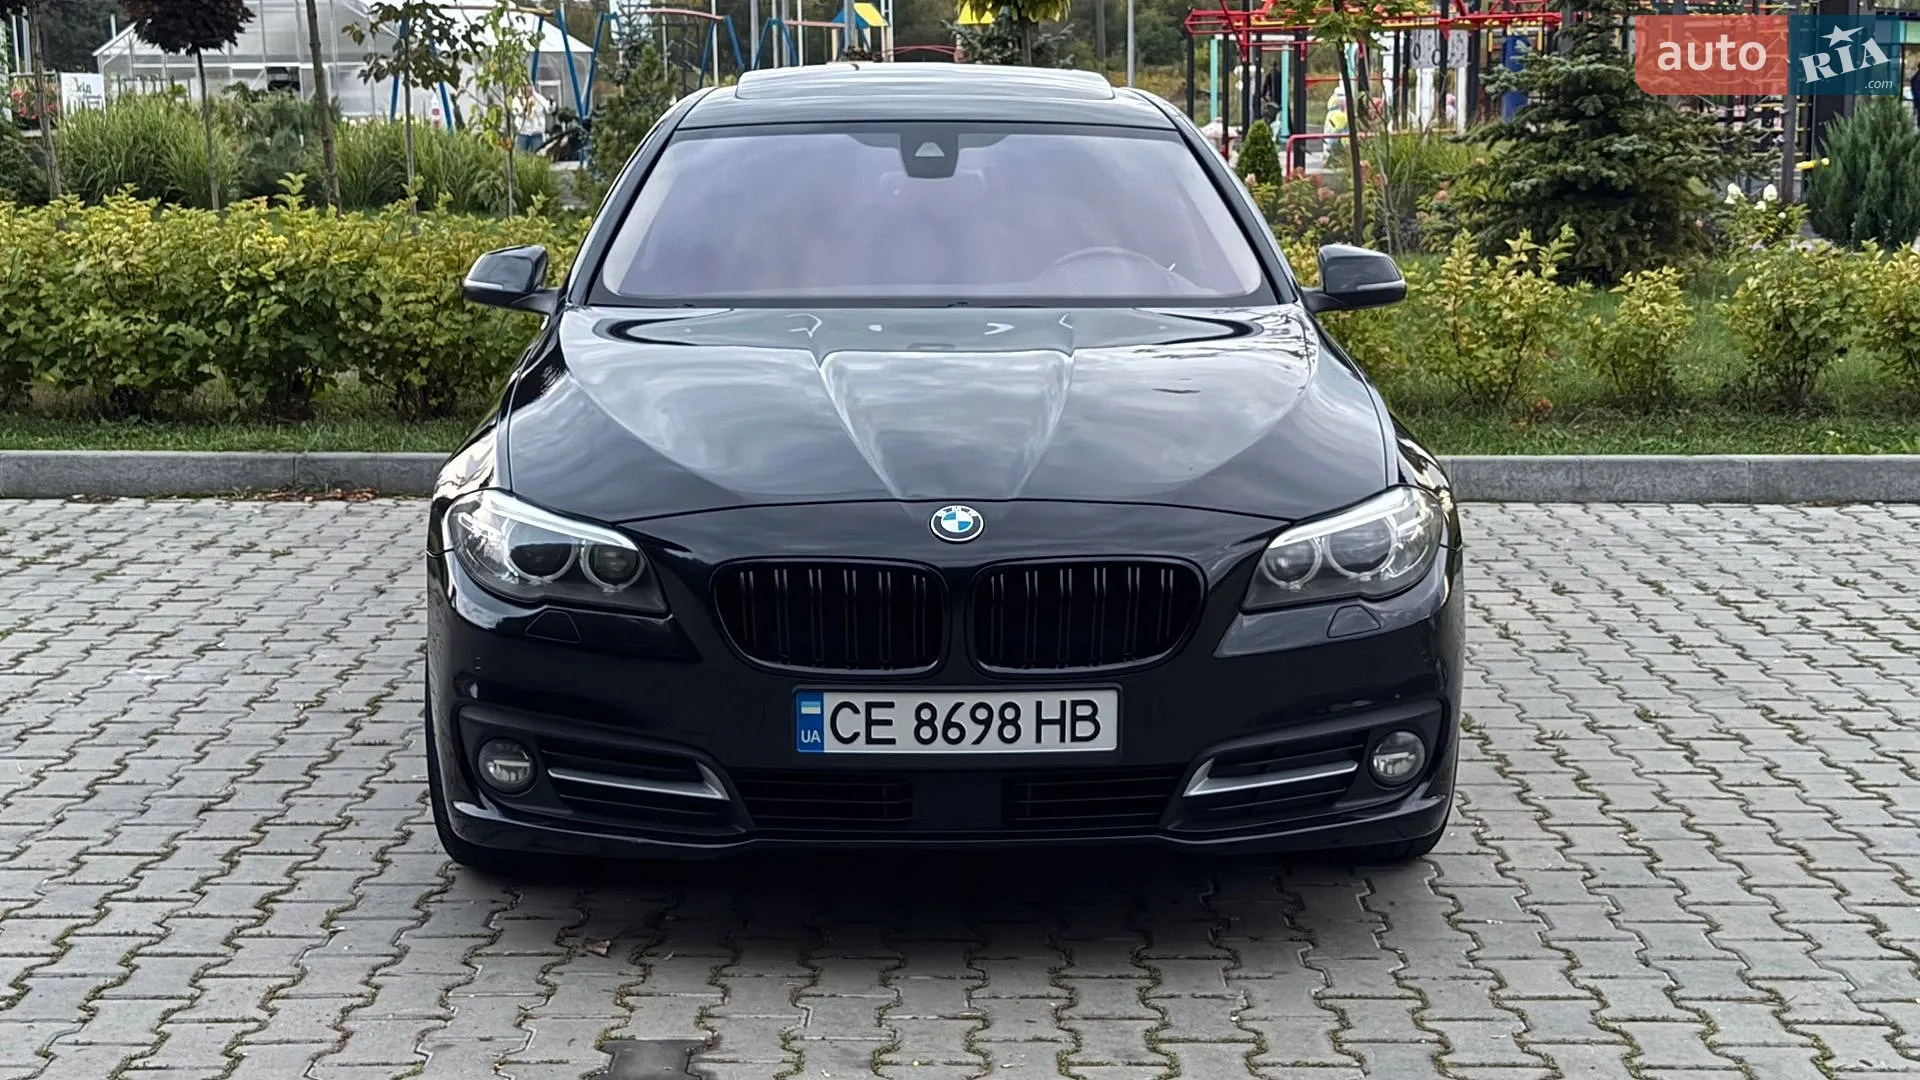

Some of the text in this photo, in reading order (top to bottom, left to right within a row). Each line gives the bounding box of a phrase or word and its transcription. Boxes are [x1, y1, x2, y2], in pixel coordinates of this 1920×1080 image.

[801, 730, 821, 743] UA
[829, 699, 1101, 745] CE 8698 HB
